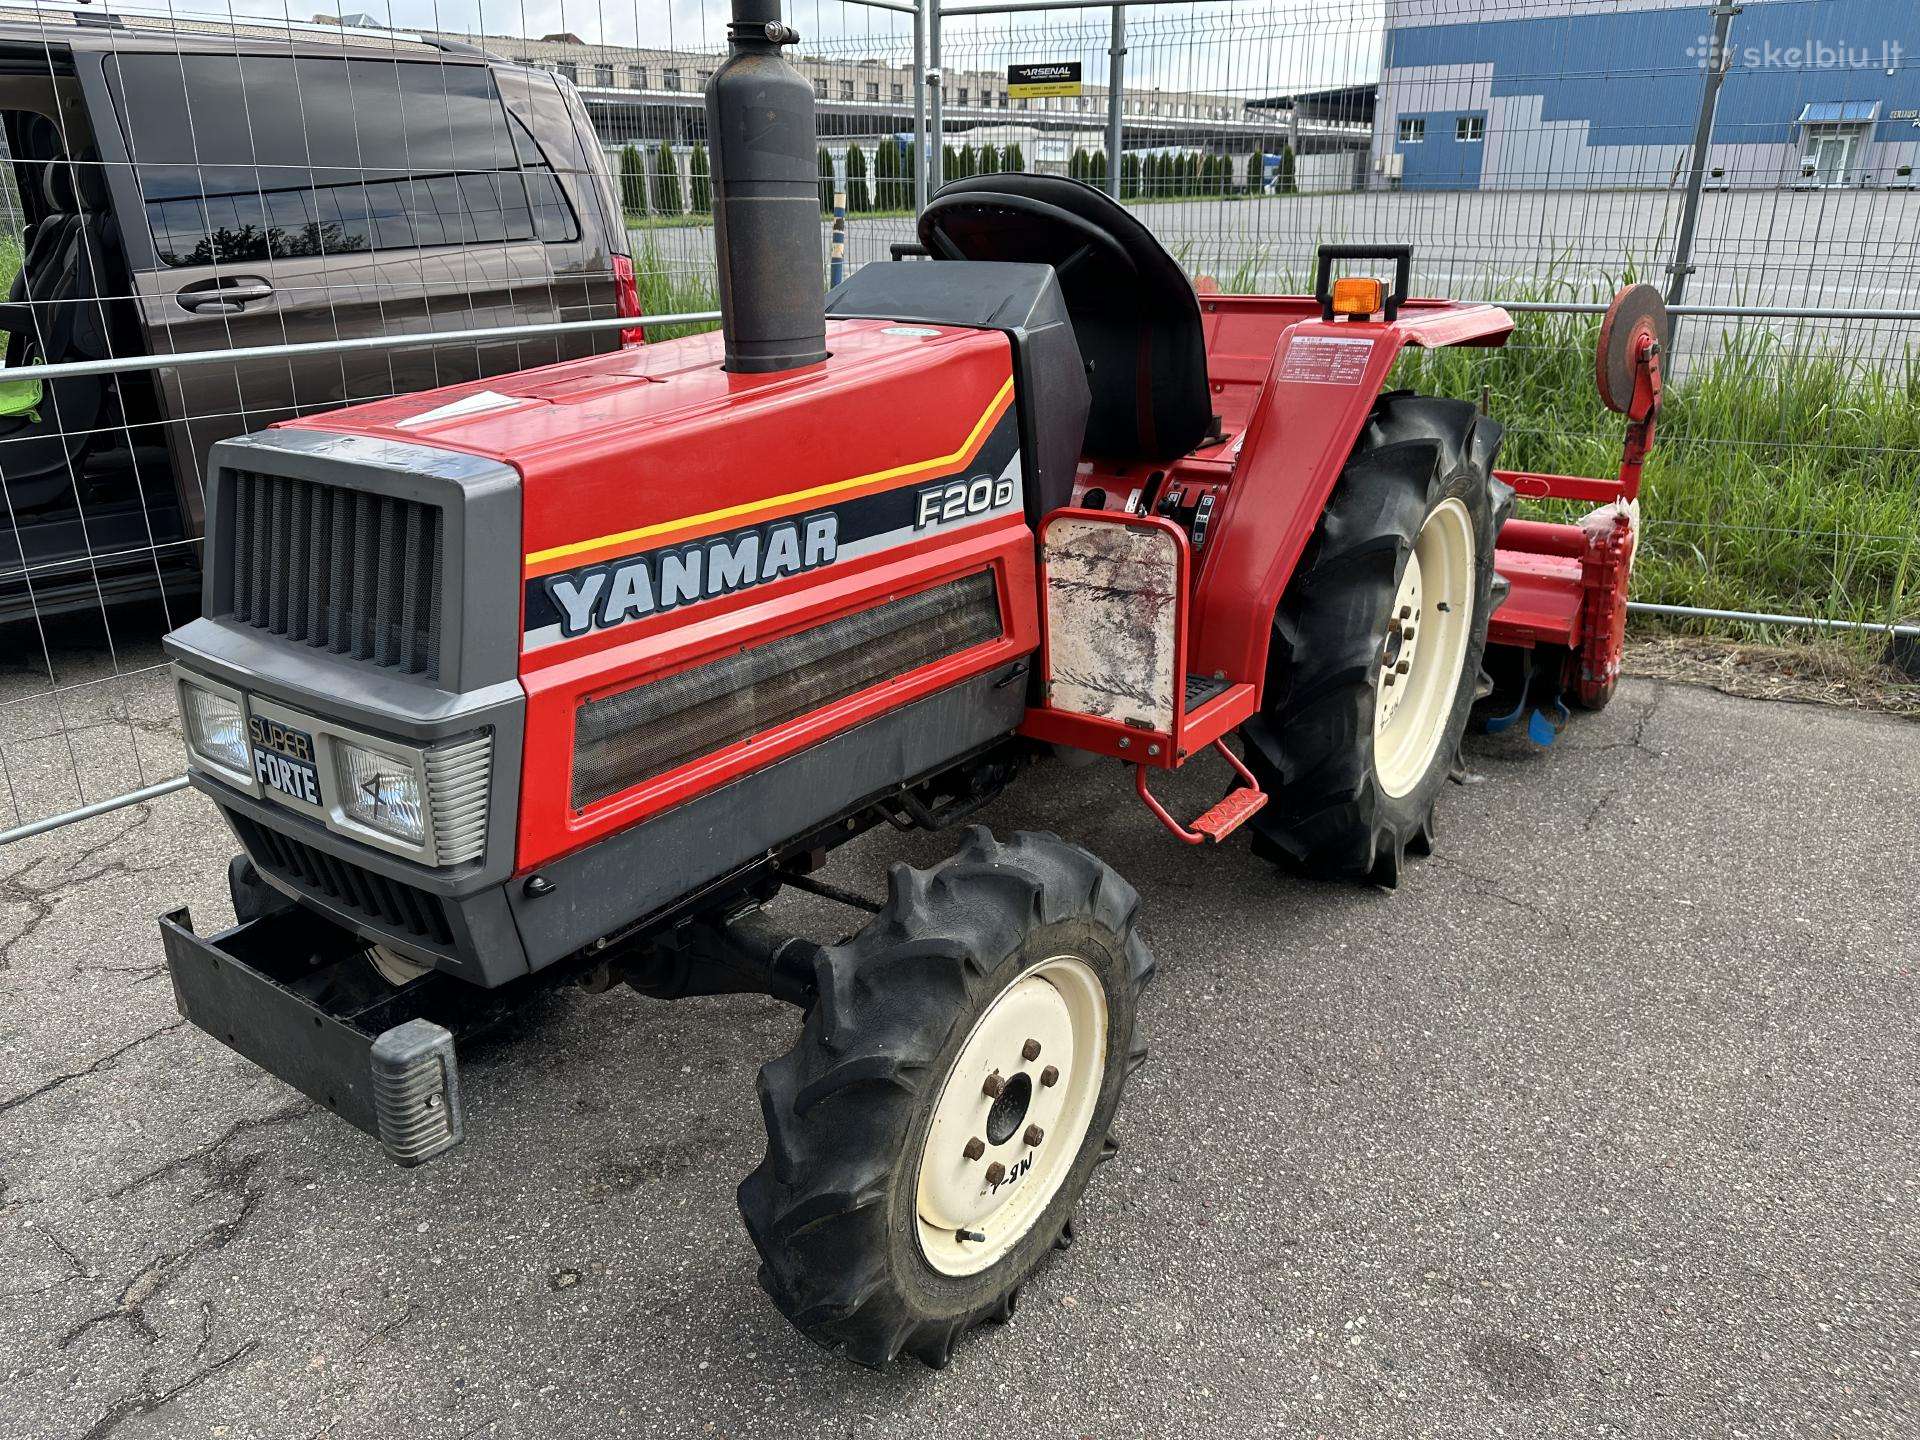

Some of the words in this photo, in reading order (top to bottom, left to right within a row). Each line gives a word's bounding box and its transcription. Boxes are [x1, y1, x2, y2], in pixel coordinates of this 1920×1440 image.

[1020, 66, 1071, 76] ARSENAL
[550, 516, 839, 632] YANMAR
[249, 717, 309, 761] SUPER
[253, 747, 318, 805] FORTE
